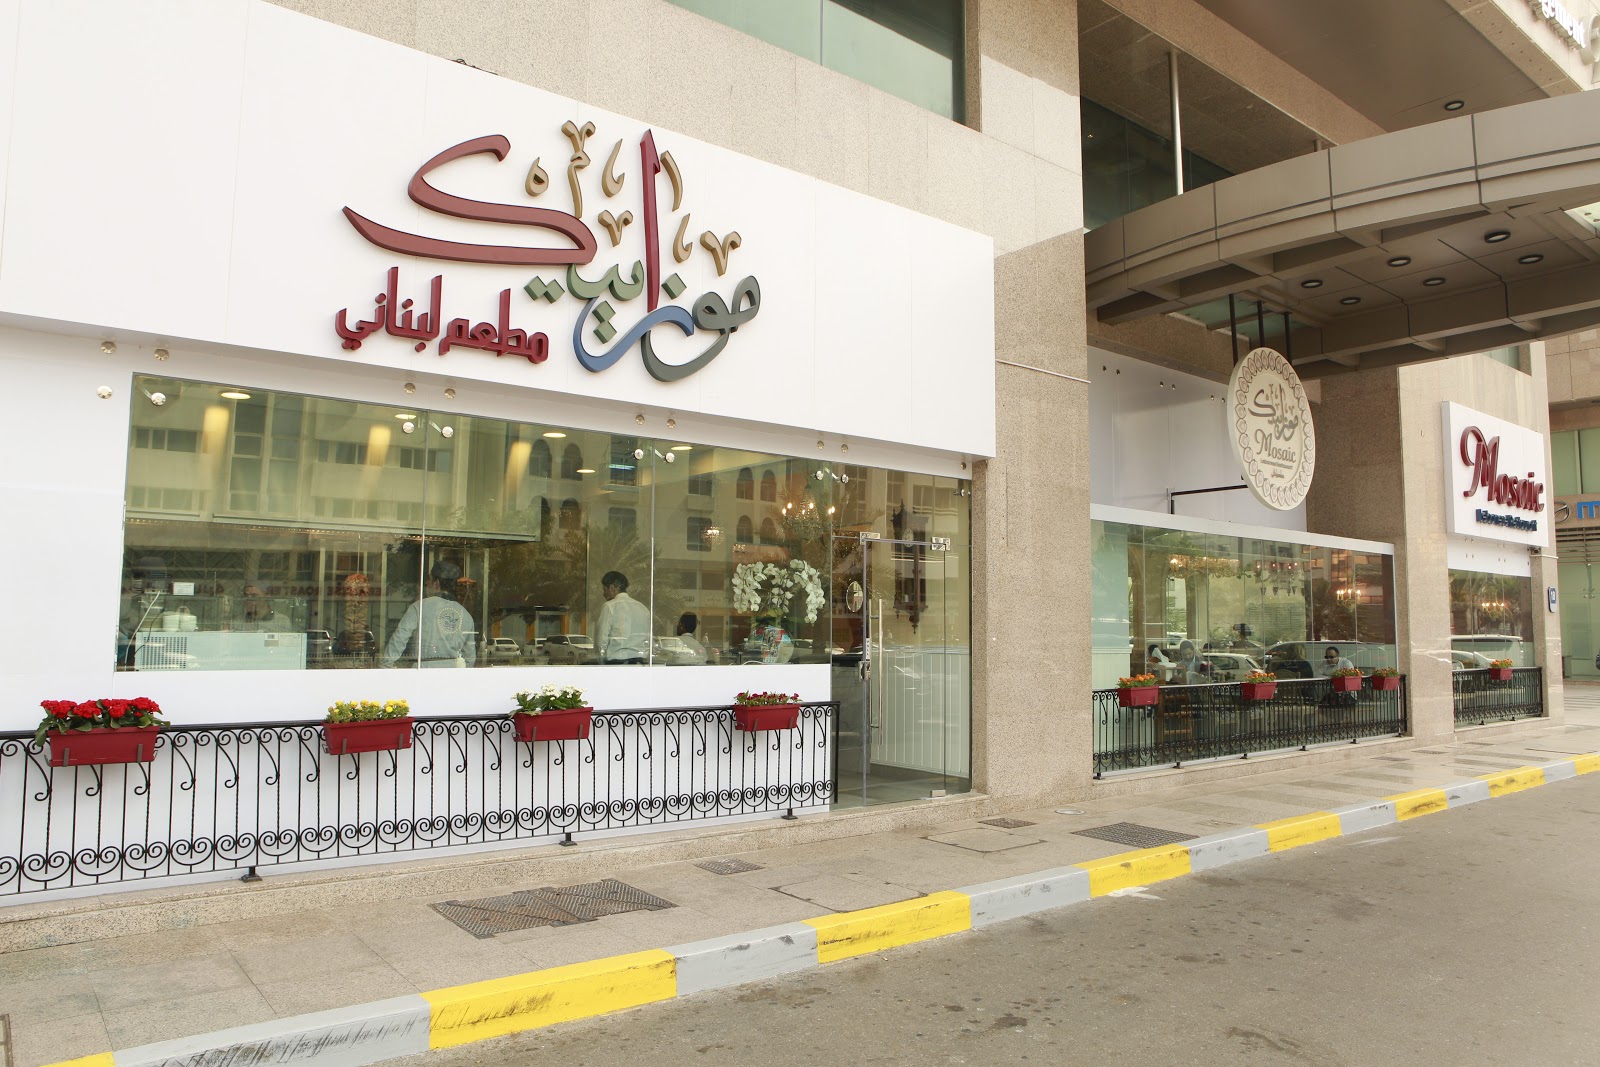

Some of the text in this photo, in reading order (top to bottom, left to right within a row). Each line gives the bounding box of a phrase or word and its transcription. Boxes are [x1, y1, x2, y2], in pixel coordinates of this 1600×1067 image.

[335, 266, 550, 364] مطعم لبناني
[1254, 428, 1297, 463] Mosaic
[1460, 425, 1545, 513] Mosaic
